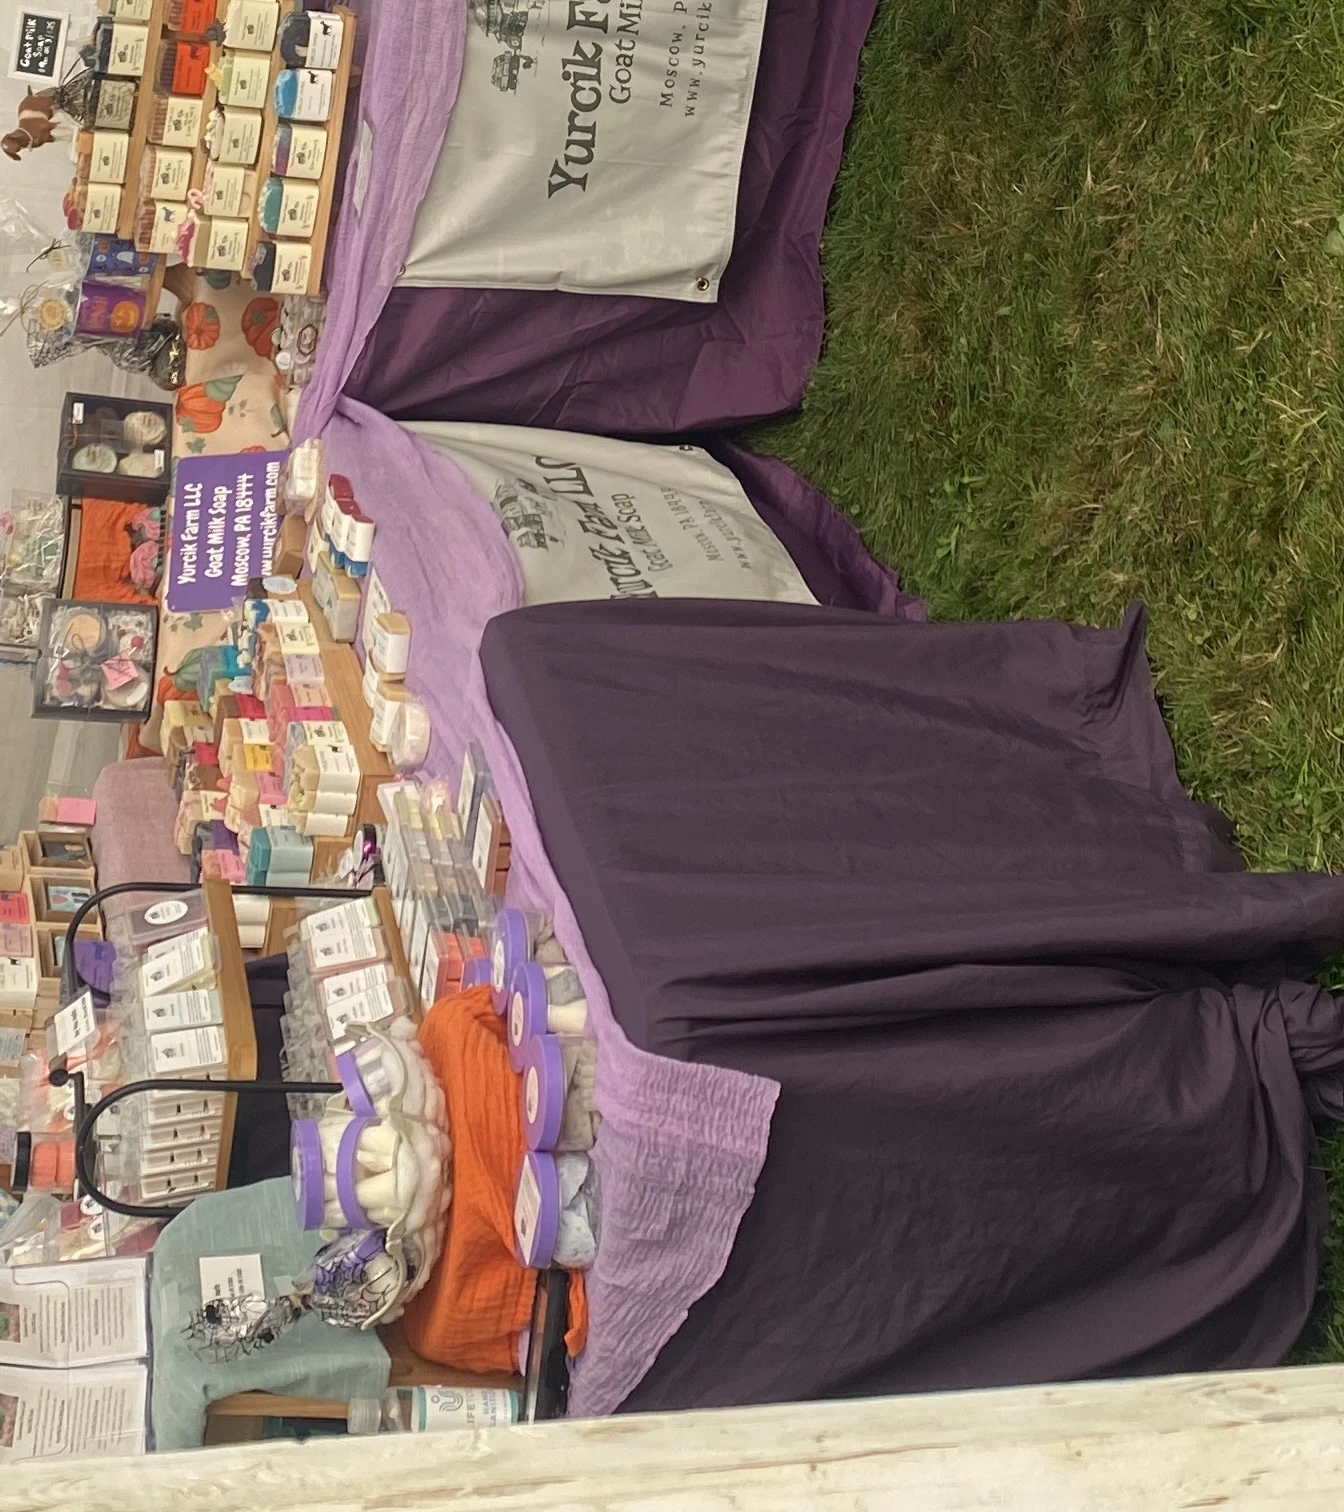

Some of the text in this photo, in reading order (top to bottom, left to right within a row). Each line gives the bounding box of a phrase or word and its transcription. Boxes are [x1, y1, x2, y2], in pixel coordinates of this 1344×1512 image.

[20, 42, 32, 68] Goat
[609, 38, 636, 104] Goat
[548, 40, 604, 199] Yurcik
[177, 483, 203, 585] Yurcik Farm LLC
[204, 486, 232, 578] Goat Milk Soap
[230, 473, 254, 586] Moscow, PA 18444
[611, 494, 642, 522] Soap
[679, 516, 699, 530] PA
[588, 543, 658, 599] urcik
